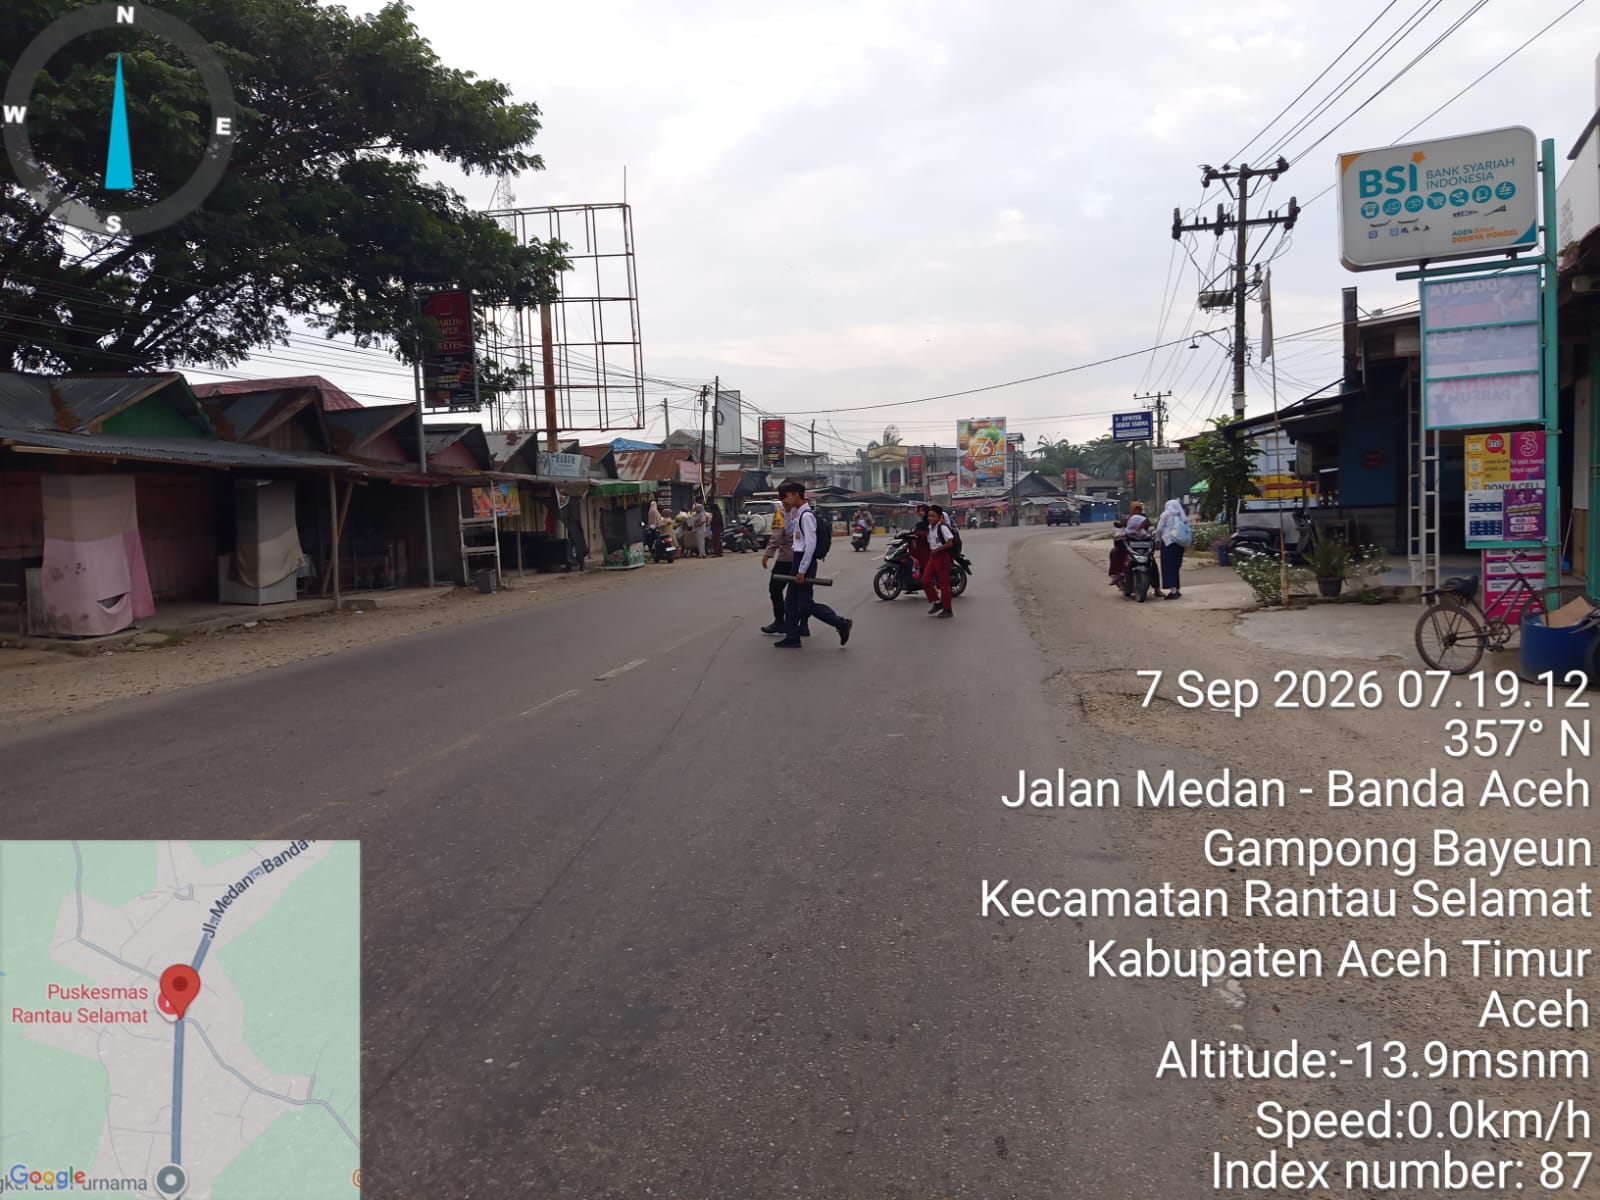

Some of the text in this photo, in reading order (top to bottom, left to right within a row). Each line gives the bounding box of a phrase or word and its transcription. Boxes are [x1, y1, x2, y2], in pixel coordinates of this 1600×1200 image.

[1359, 161, 1418, 198] BSI
[1426, 158, 1515, 180] BANK SYARIAH
[1426, 172, 1494, 190] INDONESIA
